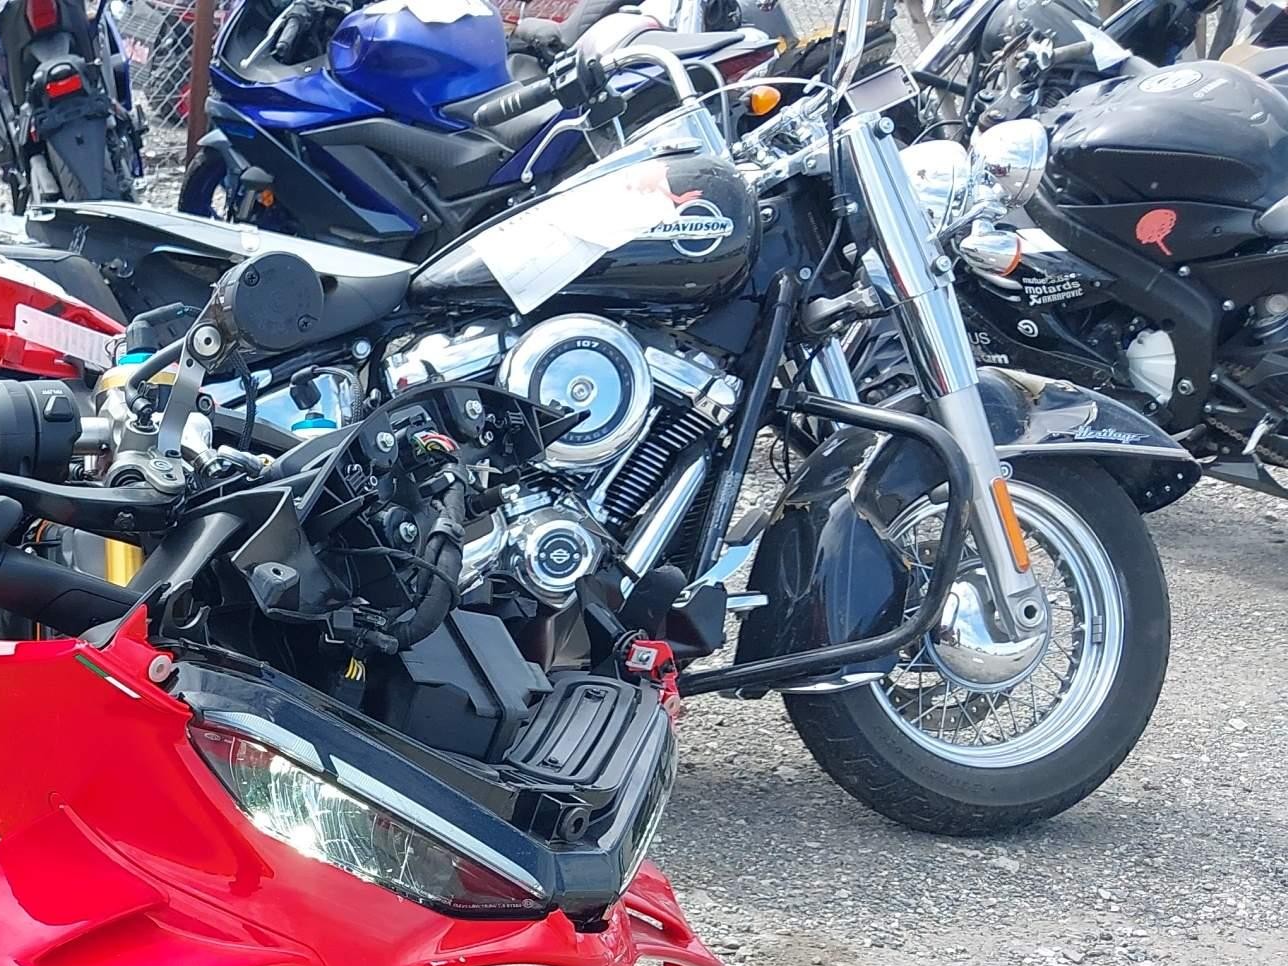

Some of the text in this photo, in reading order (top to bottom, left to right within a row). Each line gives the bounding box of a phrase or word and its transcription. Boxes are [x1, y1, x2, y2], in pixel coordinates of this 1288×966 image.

[1024, 281, 1081, 295] motards
[576, 340, 600, 349] 107
[1072, 424, 1150, 444] Heritage
